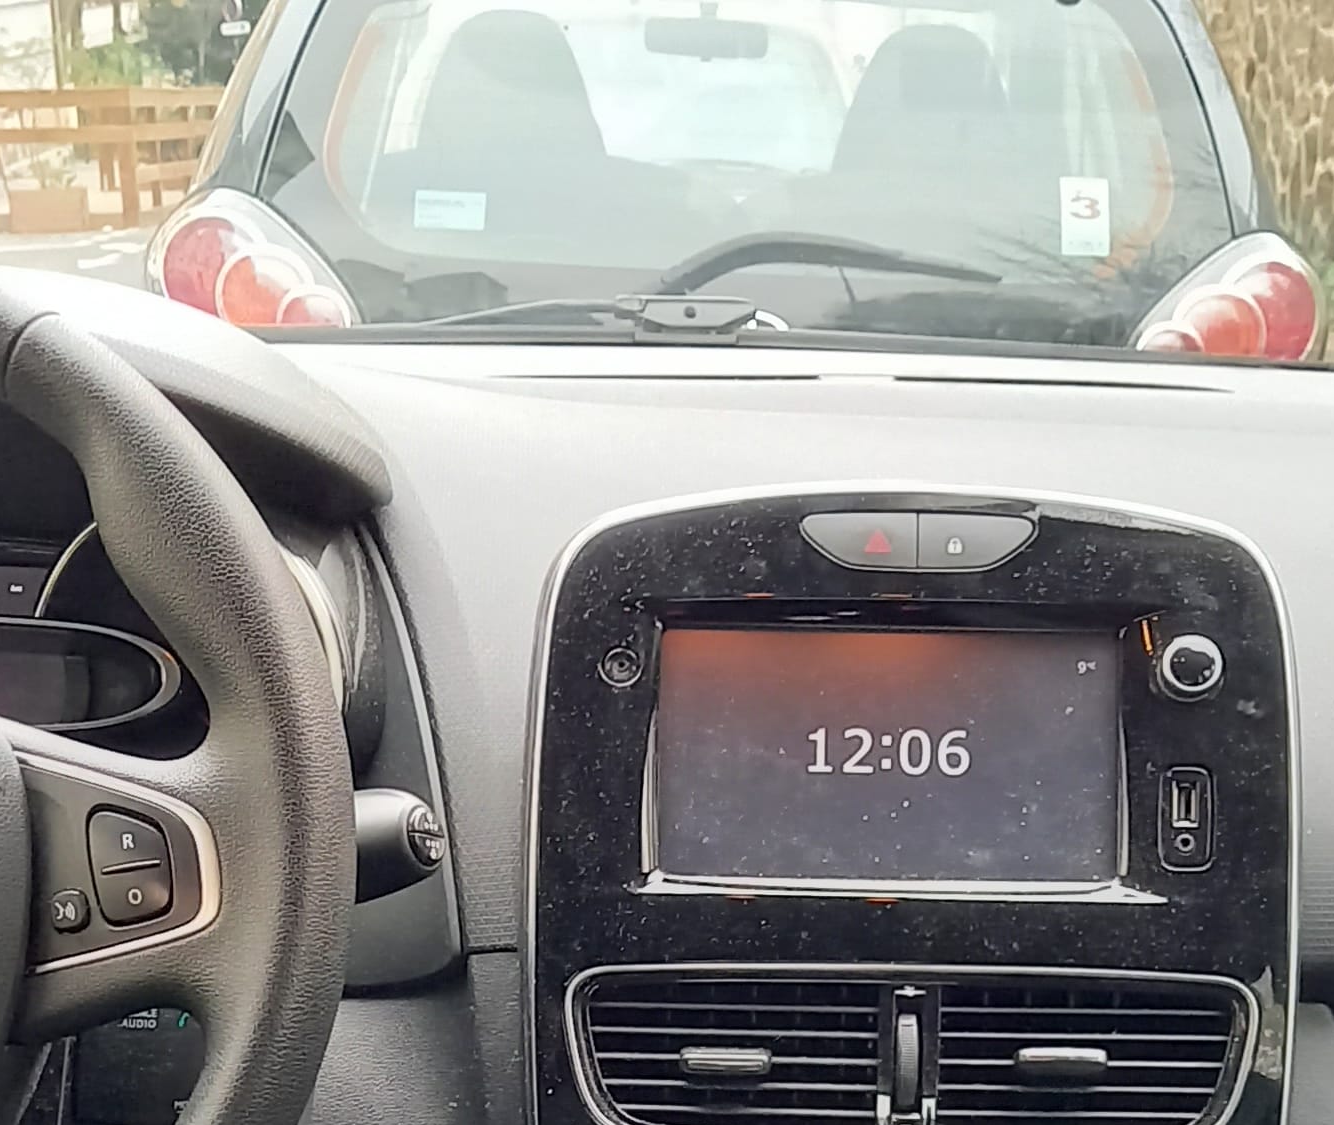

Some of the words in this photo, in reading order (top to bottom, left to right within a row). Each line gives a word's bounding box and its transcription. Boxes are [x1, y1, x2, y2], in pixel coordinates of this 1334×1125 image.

[807, 727, 970, 776] 12:06
[122, 833, 134, 850] R
[122, 1018, 157, 1029] AUDIO
